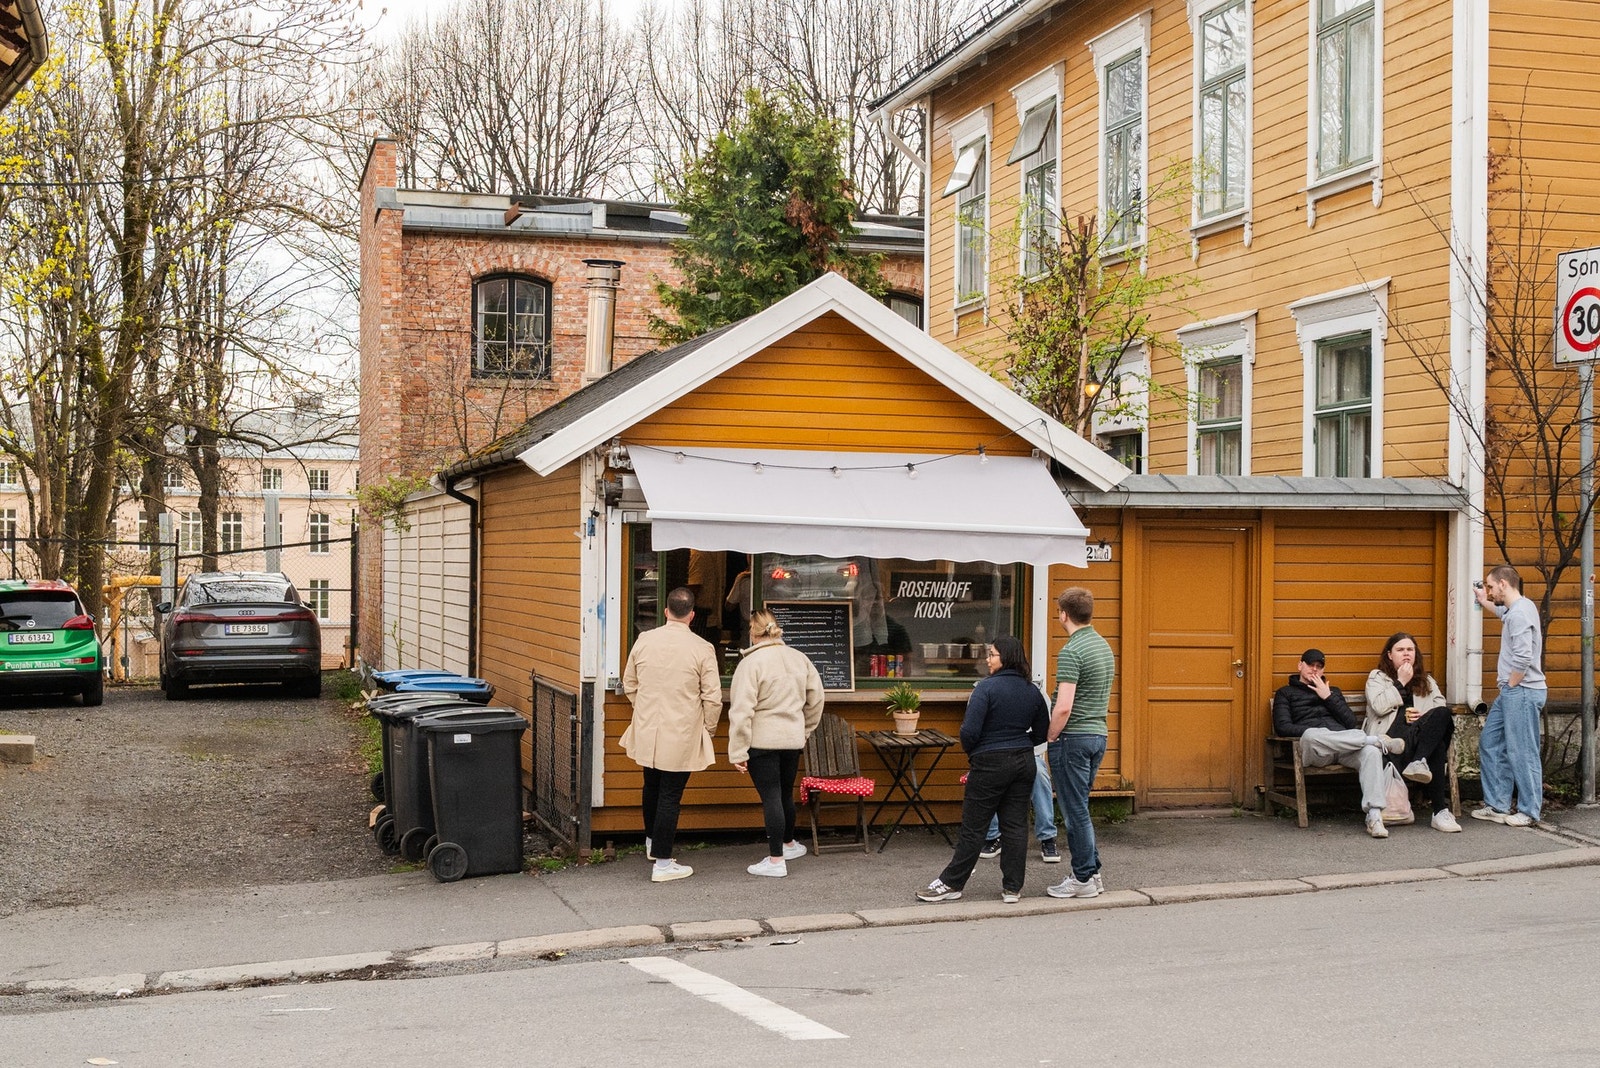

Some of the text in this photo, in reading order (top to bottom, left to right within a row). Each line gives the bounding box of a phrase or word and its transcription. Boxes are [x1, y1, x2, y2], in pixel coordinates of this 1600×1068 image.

[1572, 303, 1600, 337] 30
[897, 581, 972, 598] ROSENHOFF
[914, 602, 955, 619] KIOSK
[28, 633, 51, 642] 61342
[5, 661, 33, 669] Punjabi
